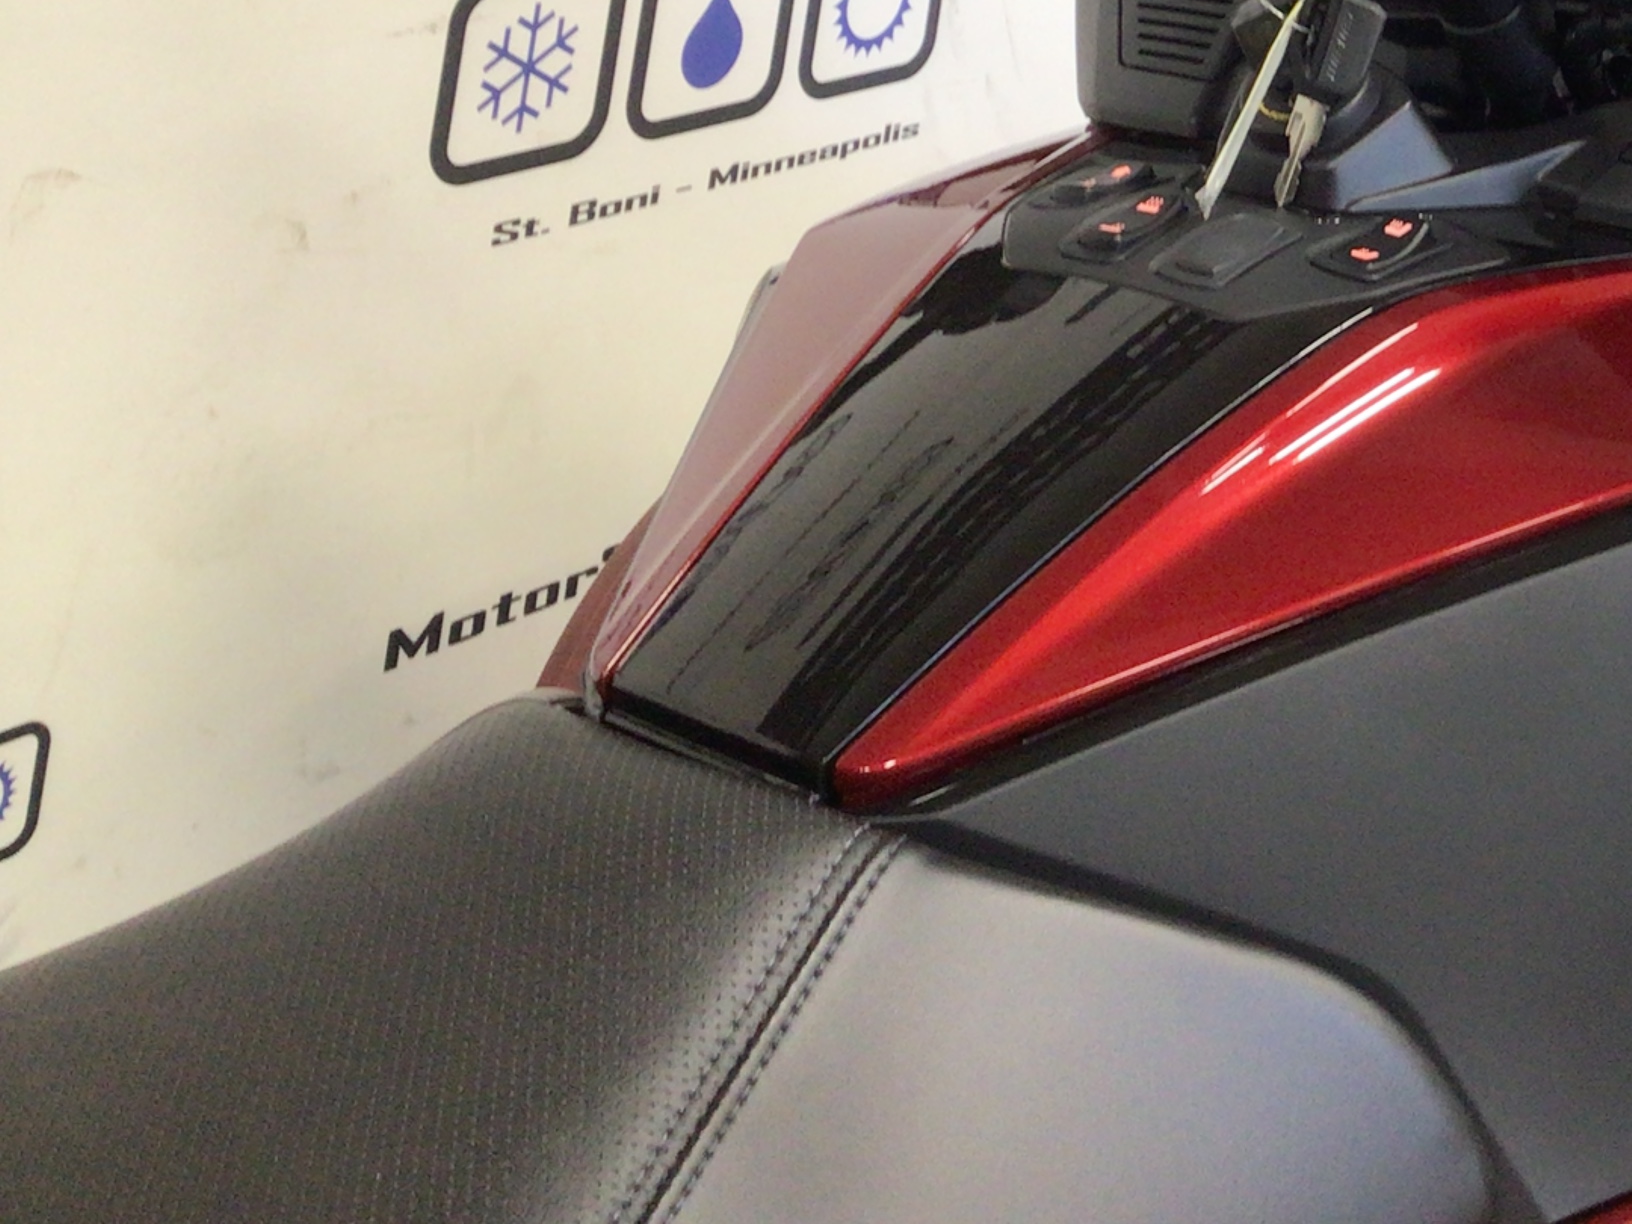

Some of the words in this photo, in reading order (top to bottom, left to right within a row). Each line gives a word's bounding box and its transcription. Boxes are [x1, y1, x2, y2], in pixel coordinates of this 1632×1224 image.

[491, 217, 550, 247] St.
[568, 184, 660, 228] Boni
[707, 122, 920, 191] Minneapolis
